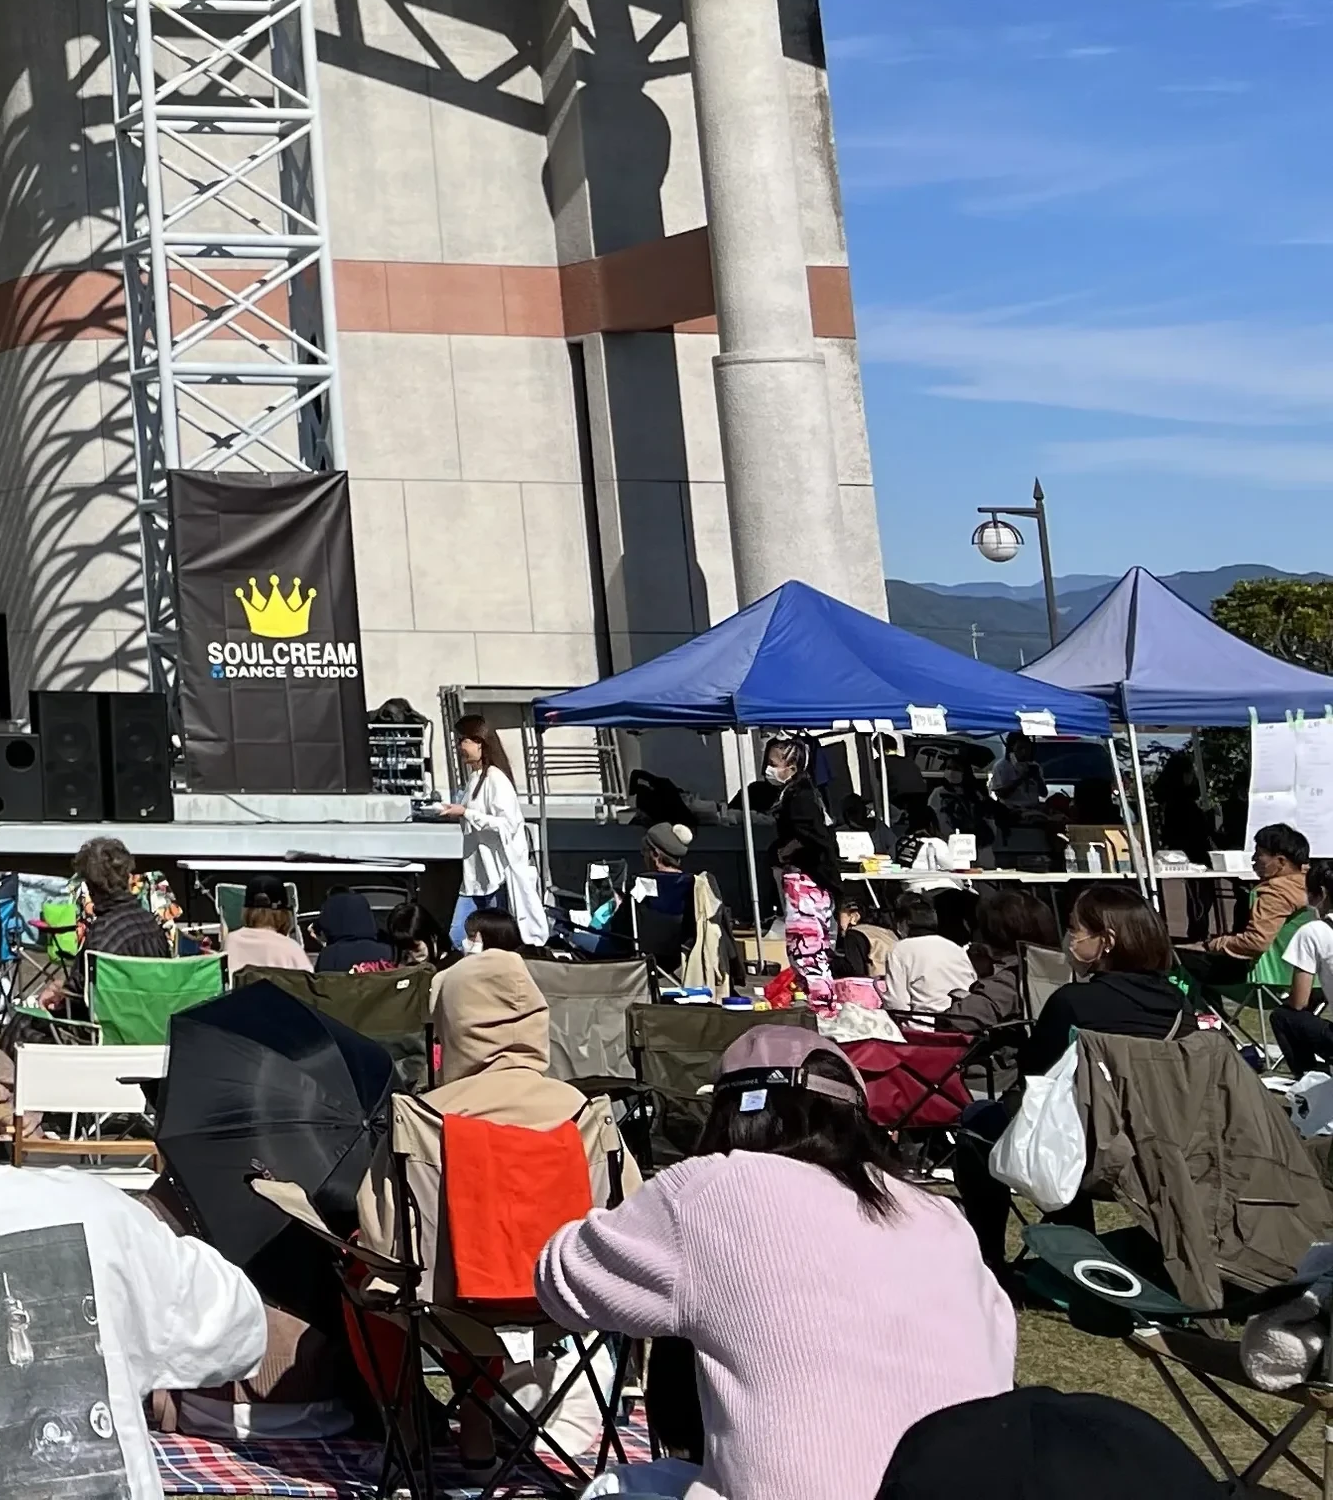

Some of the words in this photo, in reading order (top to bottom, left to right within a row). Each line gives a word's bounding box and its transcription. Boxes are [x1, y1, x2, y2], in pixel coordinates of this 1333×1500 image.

[207, 642, 357, 665] SOULCREAM
[225, 665, 287, 678] DANCE
[293, 665, 359, 678] STUDIO
